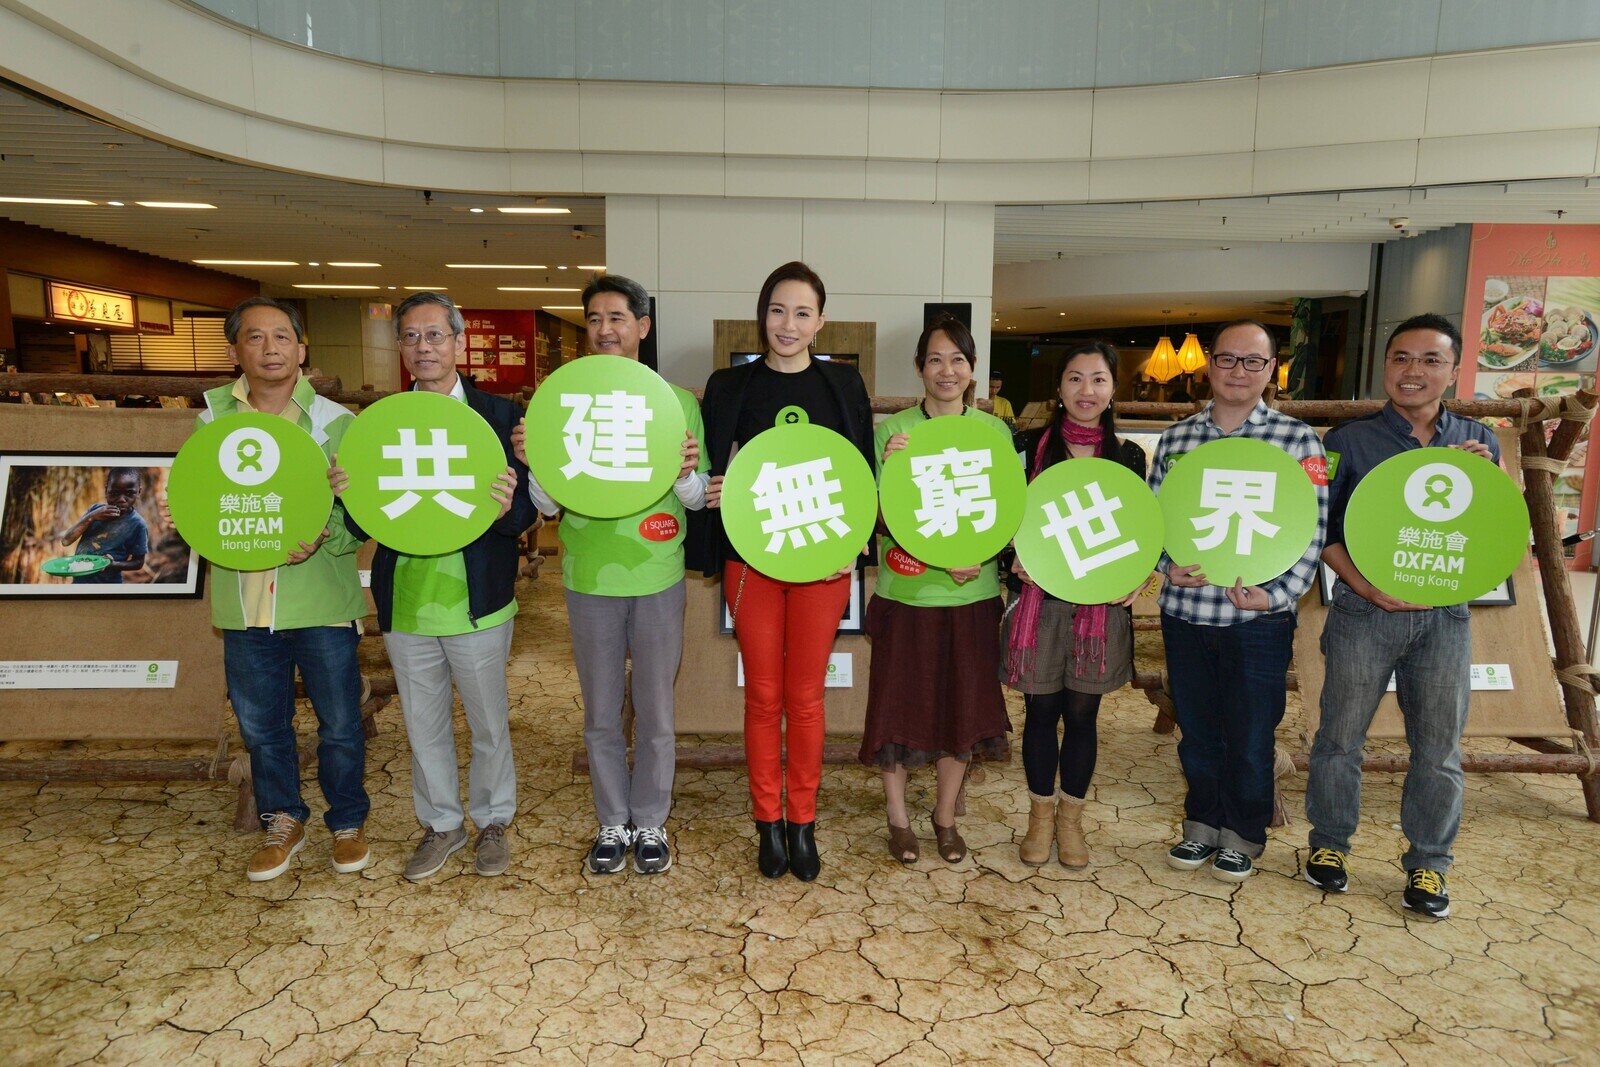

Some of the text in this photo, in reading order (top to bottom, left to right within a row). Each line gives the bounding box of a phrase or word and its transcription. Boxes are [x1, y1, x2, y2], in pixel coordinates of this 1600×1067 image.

[560, 391, 652, 482] 建
[378, 428, 477, 520] 共
[219, 492, 283, 514] 樂施會
[750, 456, 852, 554] 無
[910, 447, 997, 539] 窮
[650, 519, 675, 530] SQUARE
[1190, 469, 1281, 556] 界
[218, 516, 283, 536] OXFAM
[1041, 481, 1139, 579] 世
[1397, 526, 1469, 552] 樂施會
[221, 539, 281, 552] Hong Kong
[1393, 550, 1465, 574] OXFAM
[1393, 570, 1459, 591] Hong Kong
